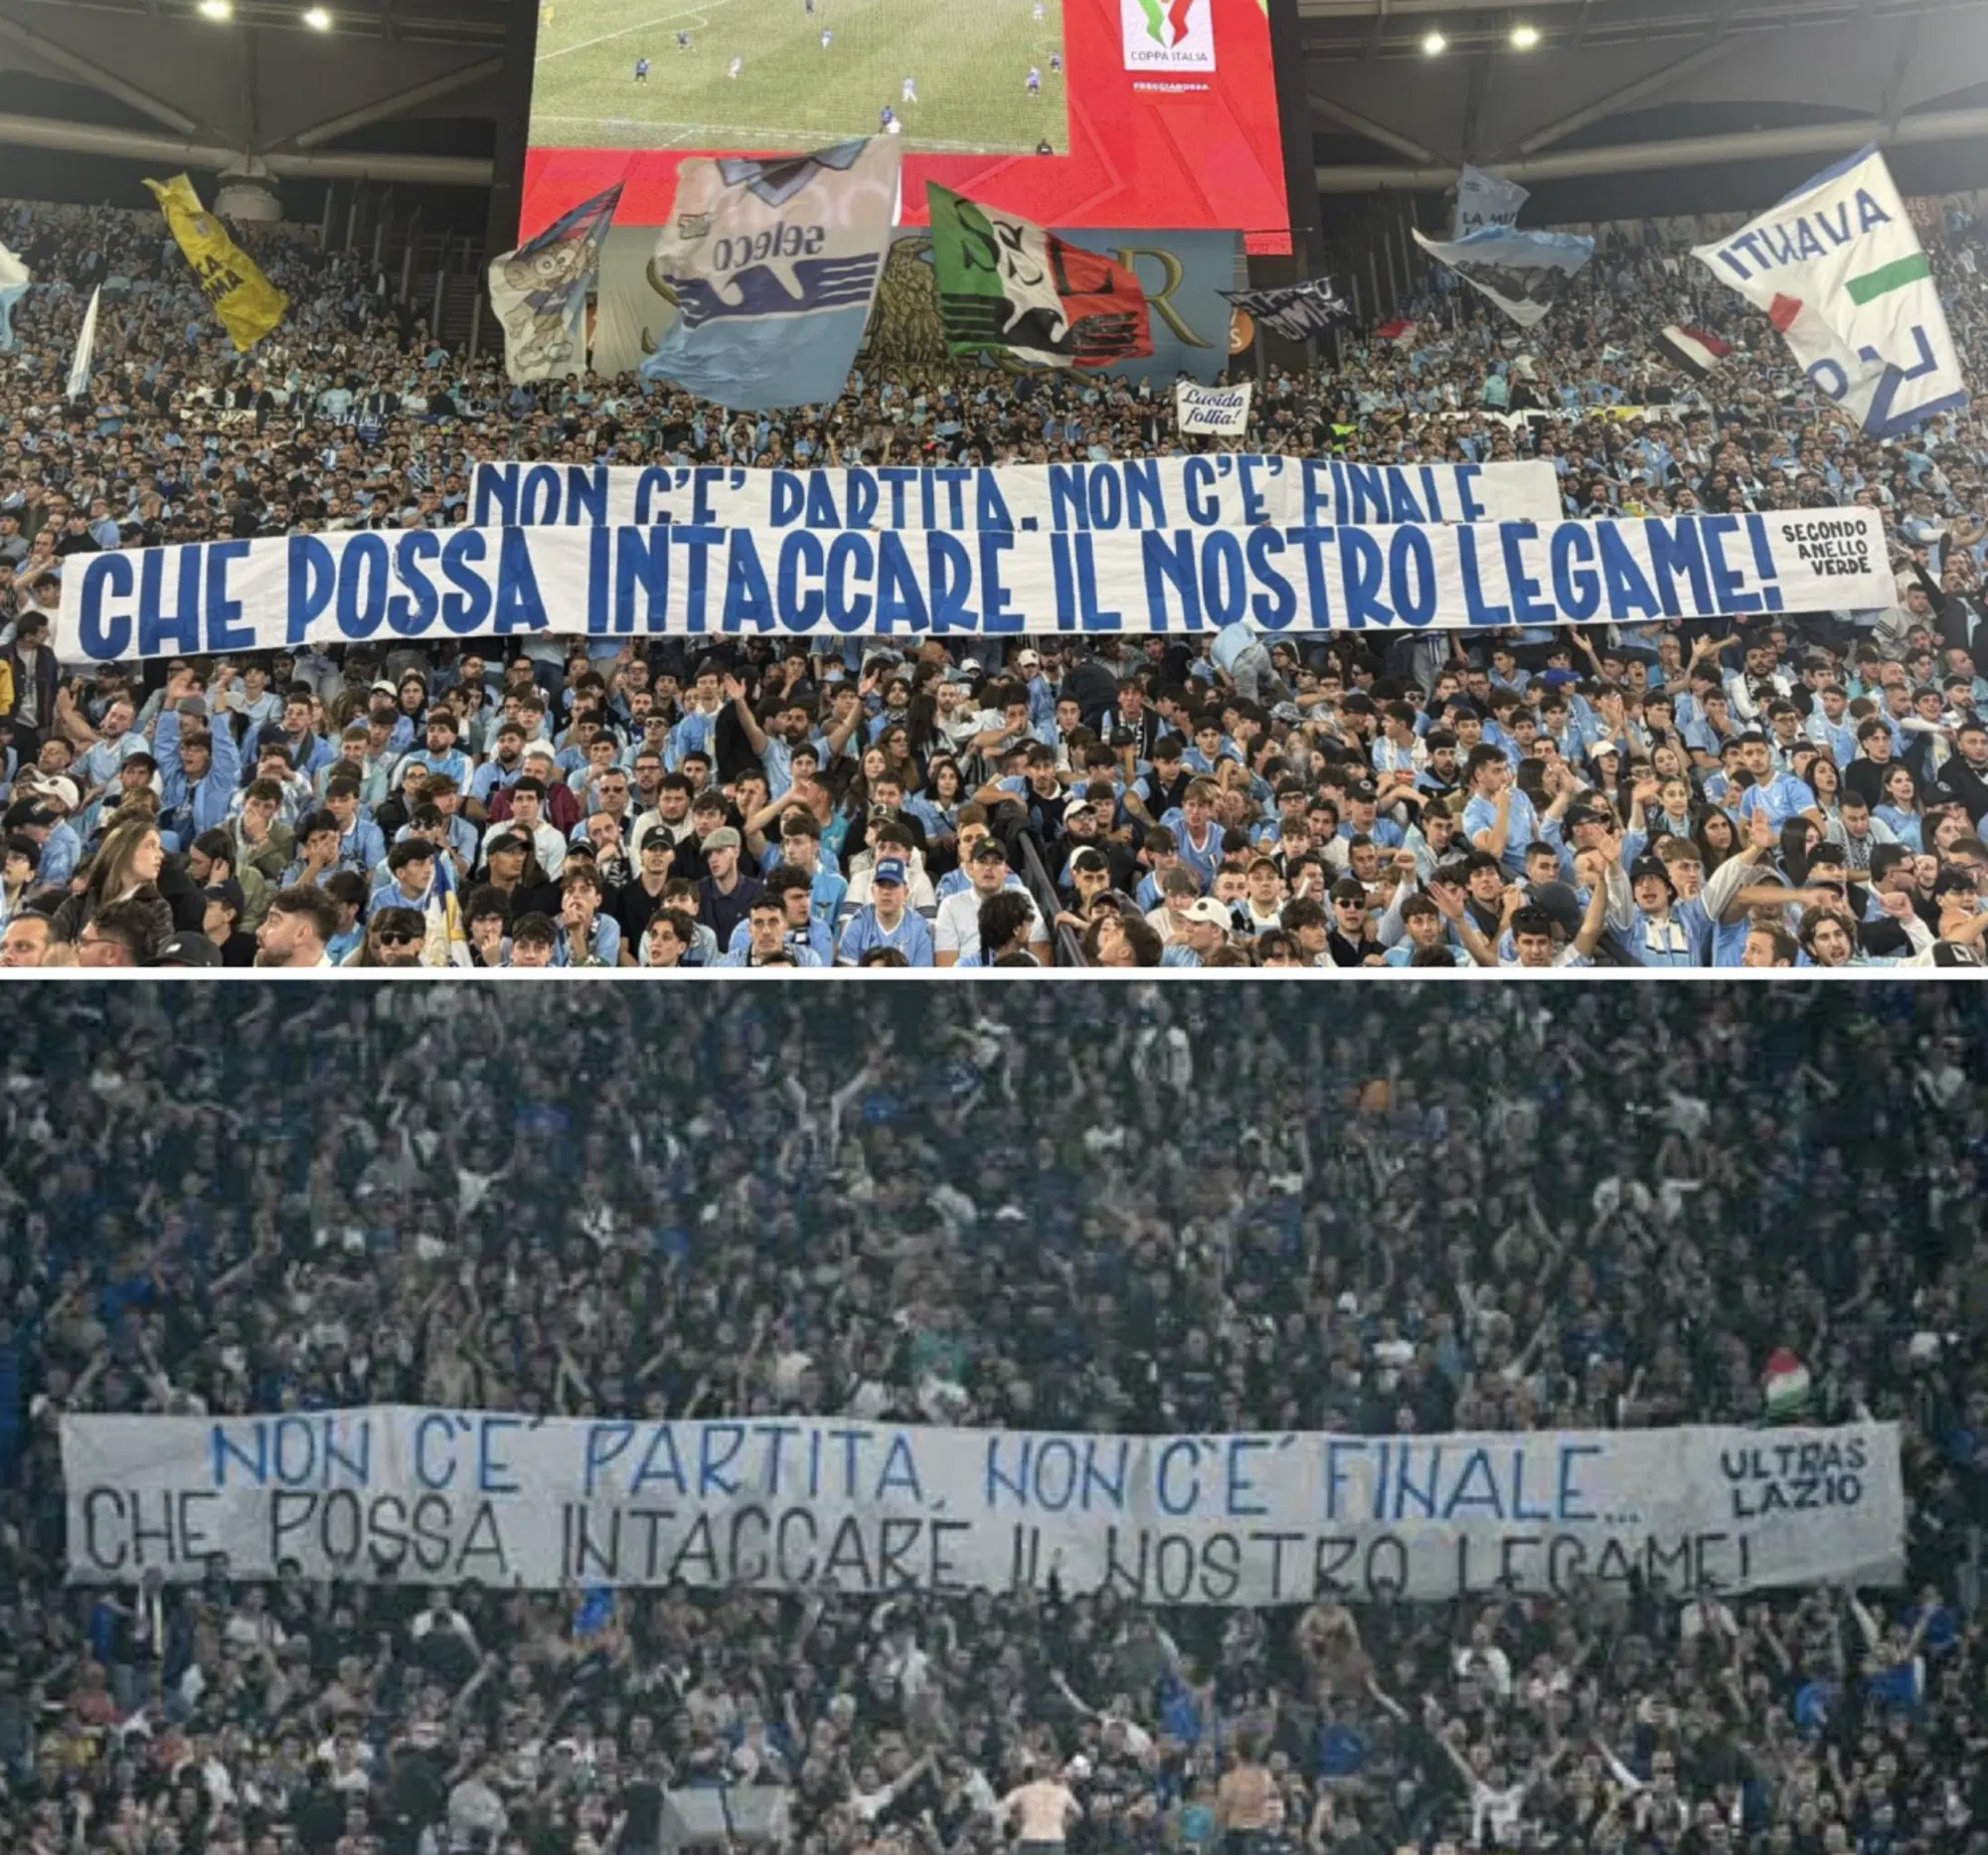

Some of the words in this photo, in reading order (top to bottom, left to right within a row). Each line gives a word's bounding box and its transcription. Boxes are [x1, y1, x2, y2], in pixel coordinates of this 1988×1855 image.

[1130, 52, 1169, 61] COPPA
[1172, 52, 1208, 62] ITALIA
[1182, 390, 1243, 408] Lucida
[1184, 406, 1242, 425] follia!
[474, 462, 609, 527] NON
[1048, 457, 1168, 531] NON
[1781, 519, 1868, 543] SECONDO
[1797, 539, 1869, 561] ANELLO
[1810, 556, 1873, 577] VERDE
[78, 540, 256, 661] CHE
[285, 525, 550, 645] POSSA
[586, 525, 1026, 634] INTACCARE
[1050, 531, 1122, 631] IL
[1141, 522, 1437, 631] NOSTRO
[1457, 513, 1785, 626] LEGAME!
[211, 1415, 371, 1486] NON
[984, 1435, 1128, 1510] NON
[1720, 1436, 1869, 1481] ULTRAS
[1734, 1475, 1865, 1519] LAZIO
[83, 1485, 222, 1571] CHE
[269, 1488, 508, 1576] POSSA
[559, 1501, 972, 1590] INTACCARE
[1104, 1524, 1409, 1604] NOSTRO
